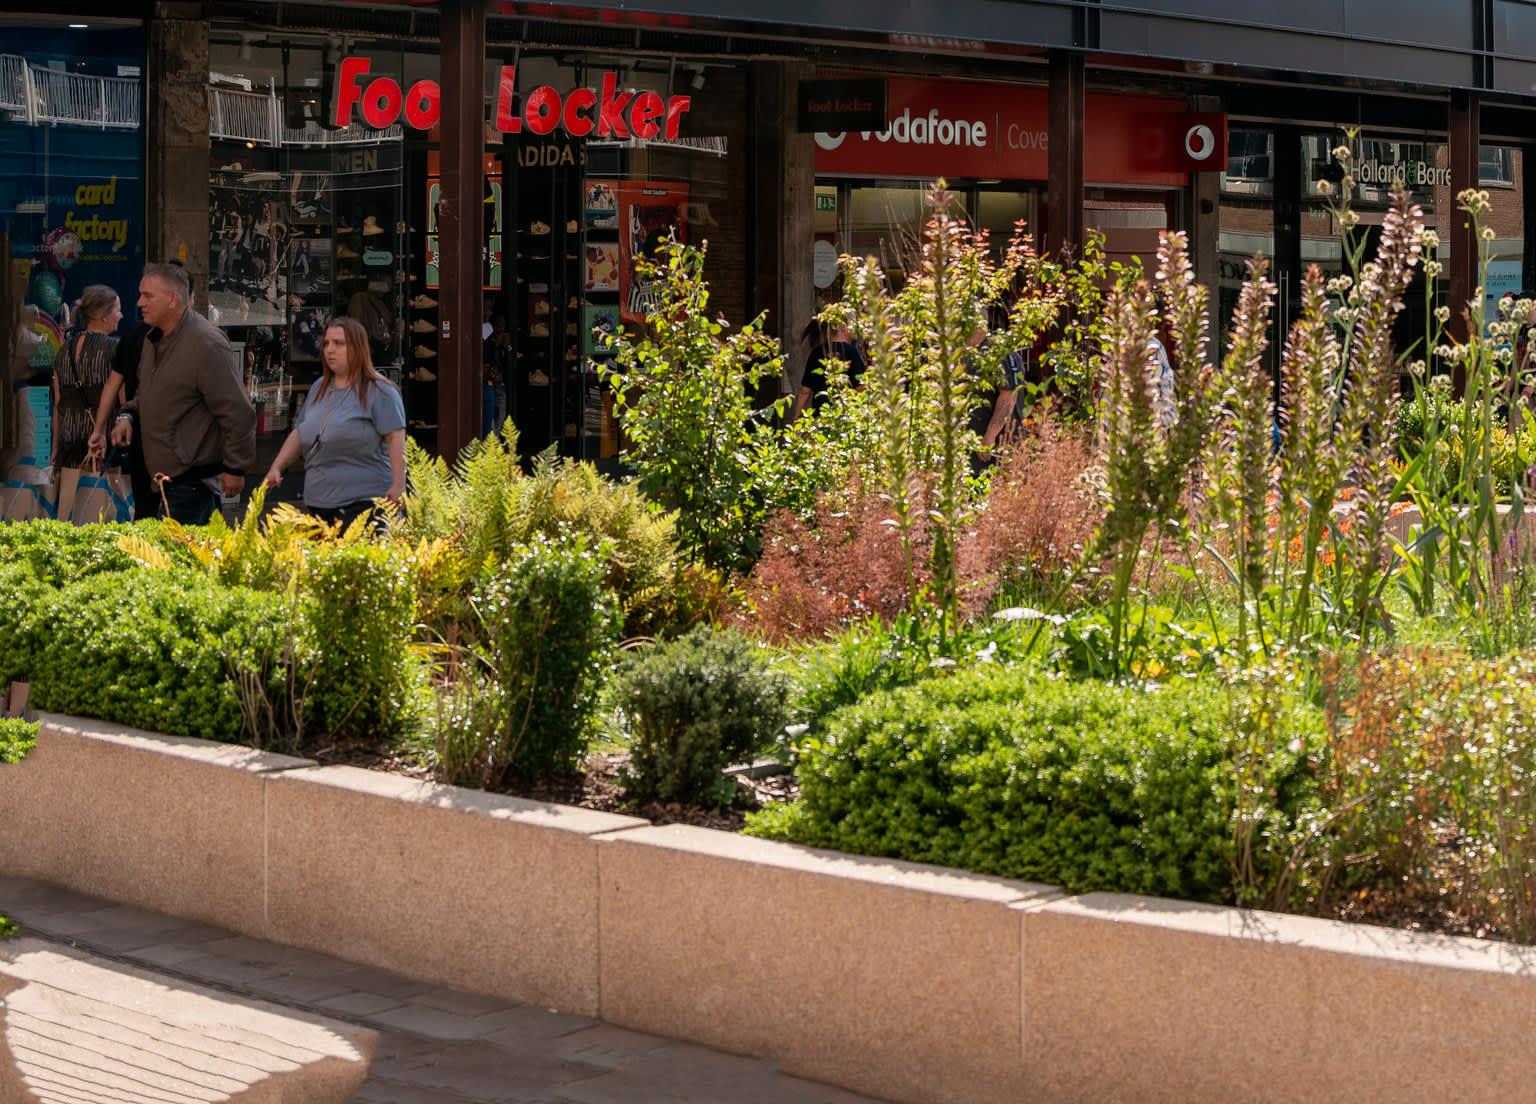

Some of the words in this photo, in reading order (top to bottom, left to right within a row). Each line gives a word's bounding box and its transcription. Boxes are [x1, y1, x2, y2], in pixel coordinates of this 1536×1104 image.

[334, 56, 441, 132] Foo
[494, 64, 692, 140] Locker
[1007, 123, 1048, 150] Cove
[1417, 161, 1451, 187] Barre
[75, 175, 118, 207] card
